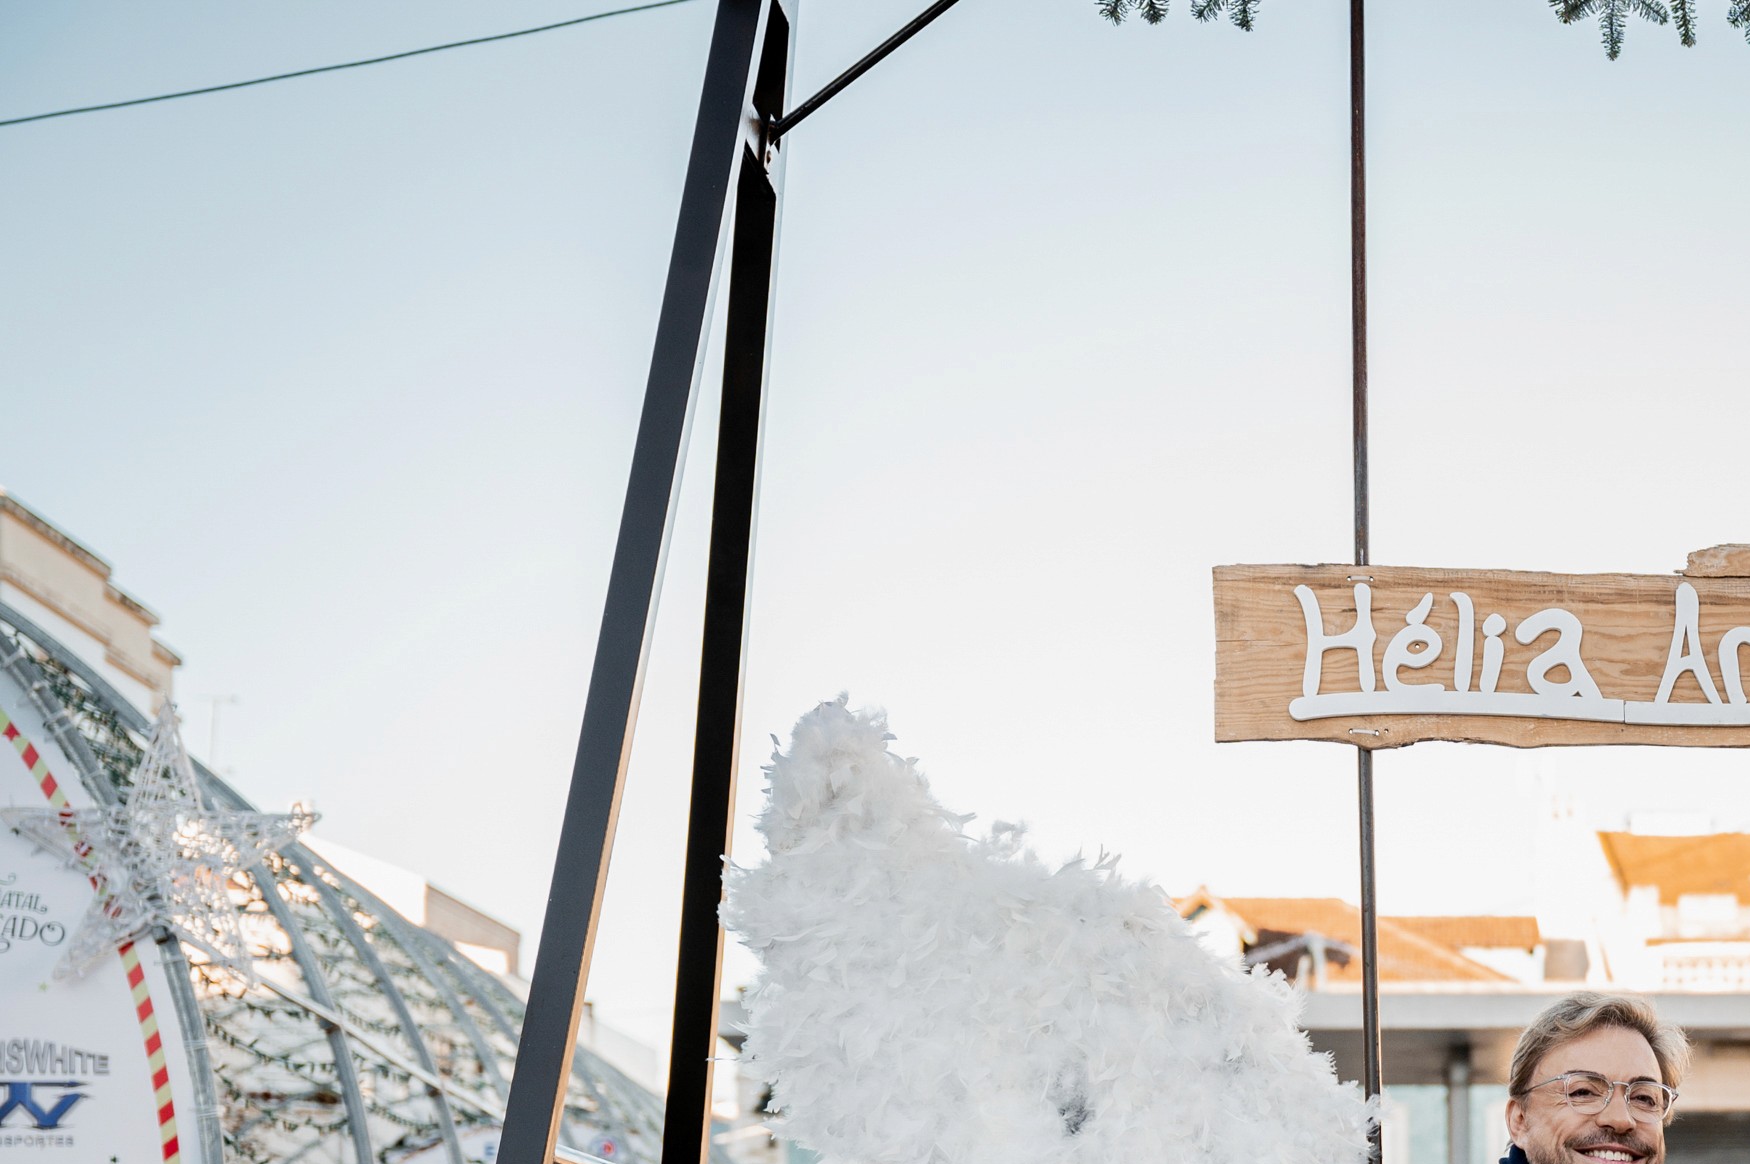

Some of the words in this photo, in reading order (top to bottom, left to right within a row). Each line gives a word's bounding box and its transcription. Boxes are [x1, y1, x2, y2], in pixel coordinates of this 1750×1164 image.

[1293, 582, 1604, 700] Hélia
[0, 914, 66, 947] ADO
[0, 1133, 75, 1149] SPORTES
